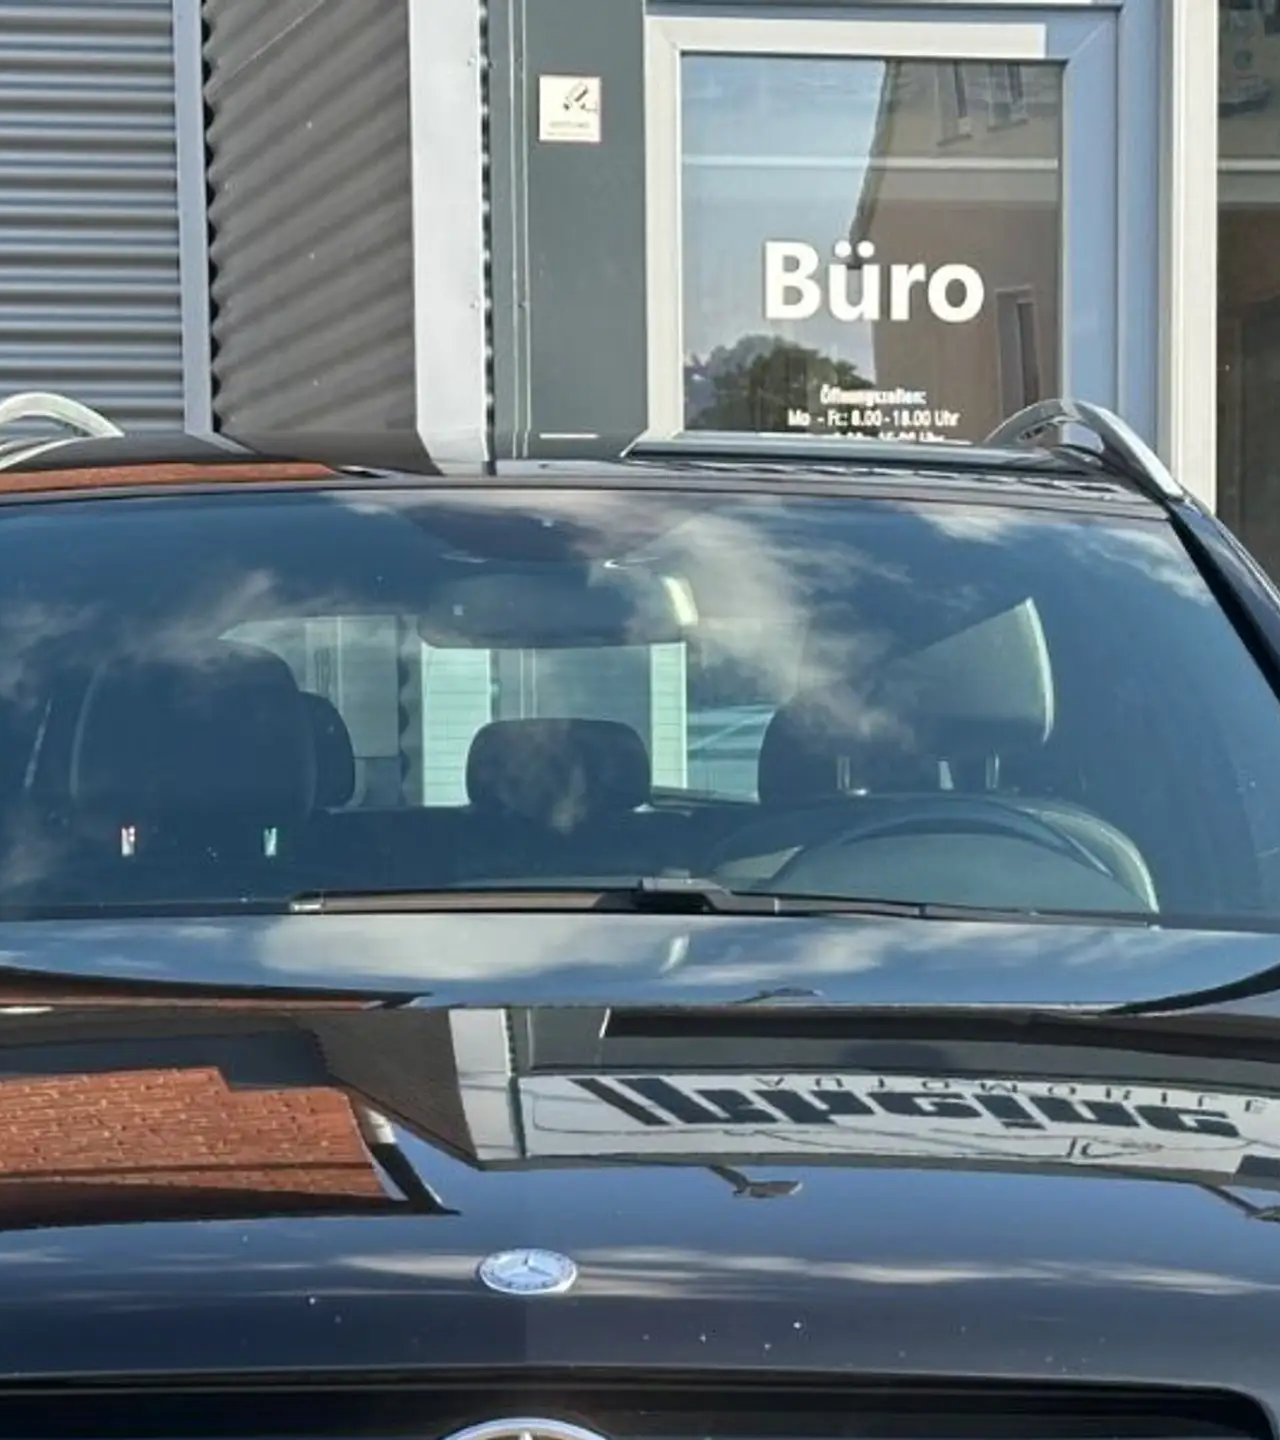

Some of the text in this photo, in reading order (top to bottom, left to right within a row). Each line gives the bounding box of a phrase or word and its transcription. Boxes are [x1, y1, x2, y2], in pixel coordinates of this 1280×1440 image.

[764, 240, 985, 323] Büro
[787, 408, 811, 427] Mo
[934, 408, 962, 427] Uhr
